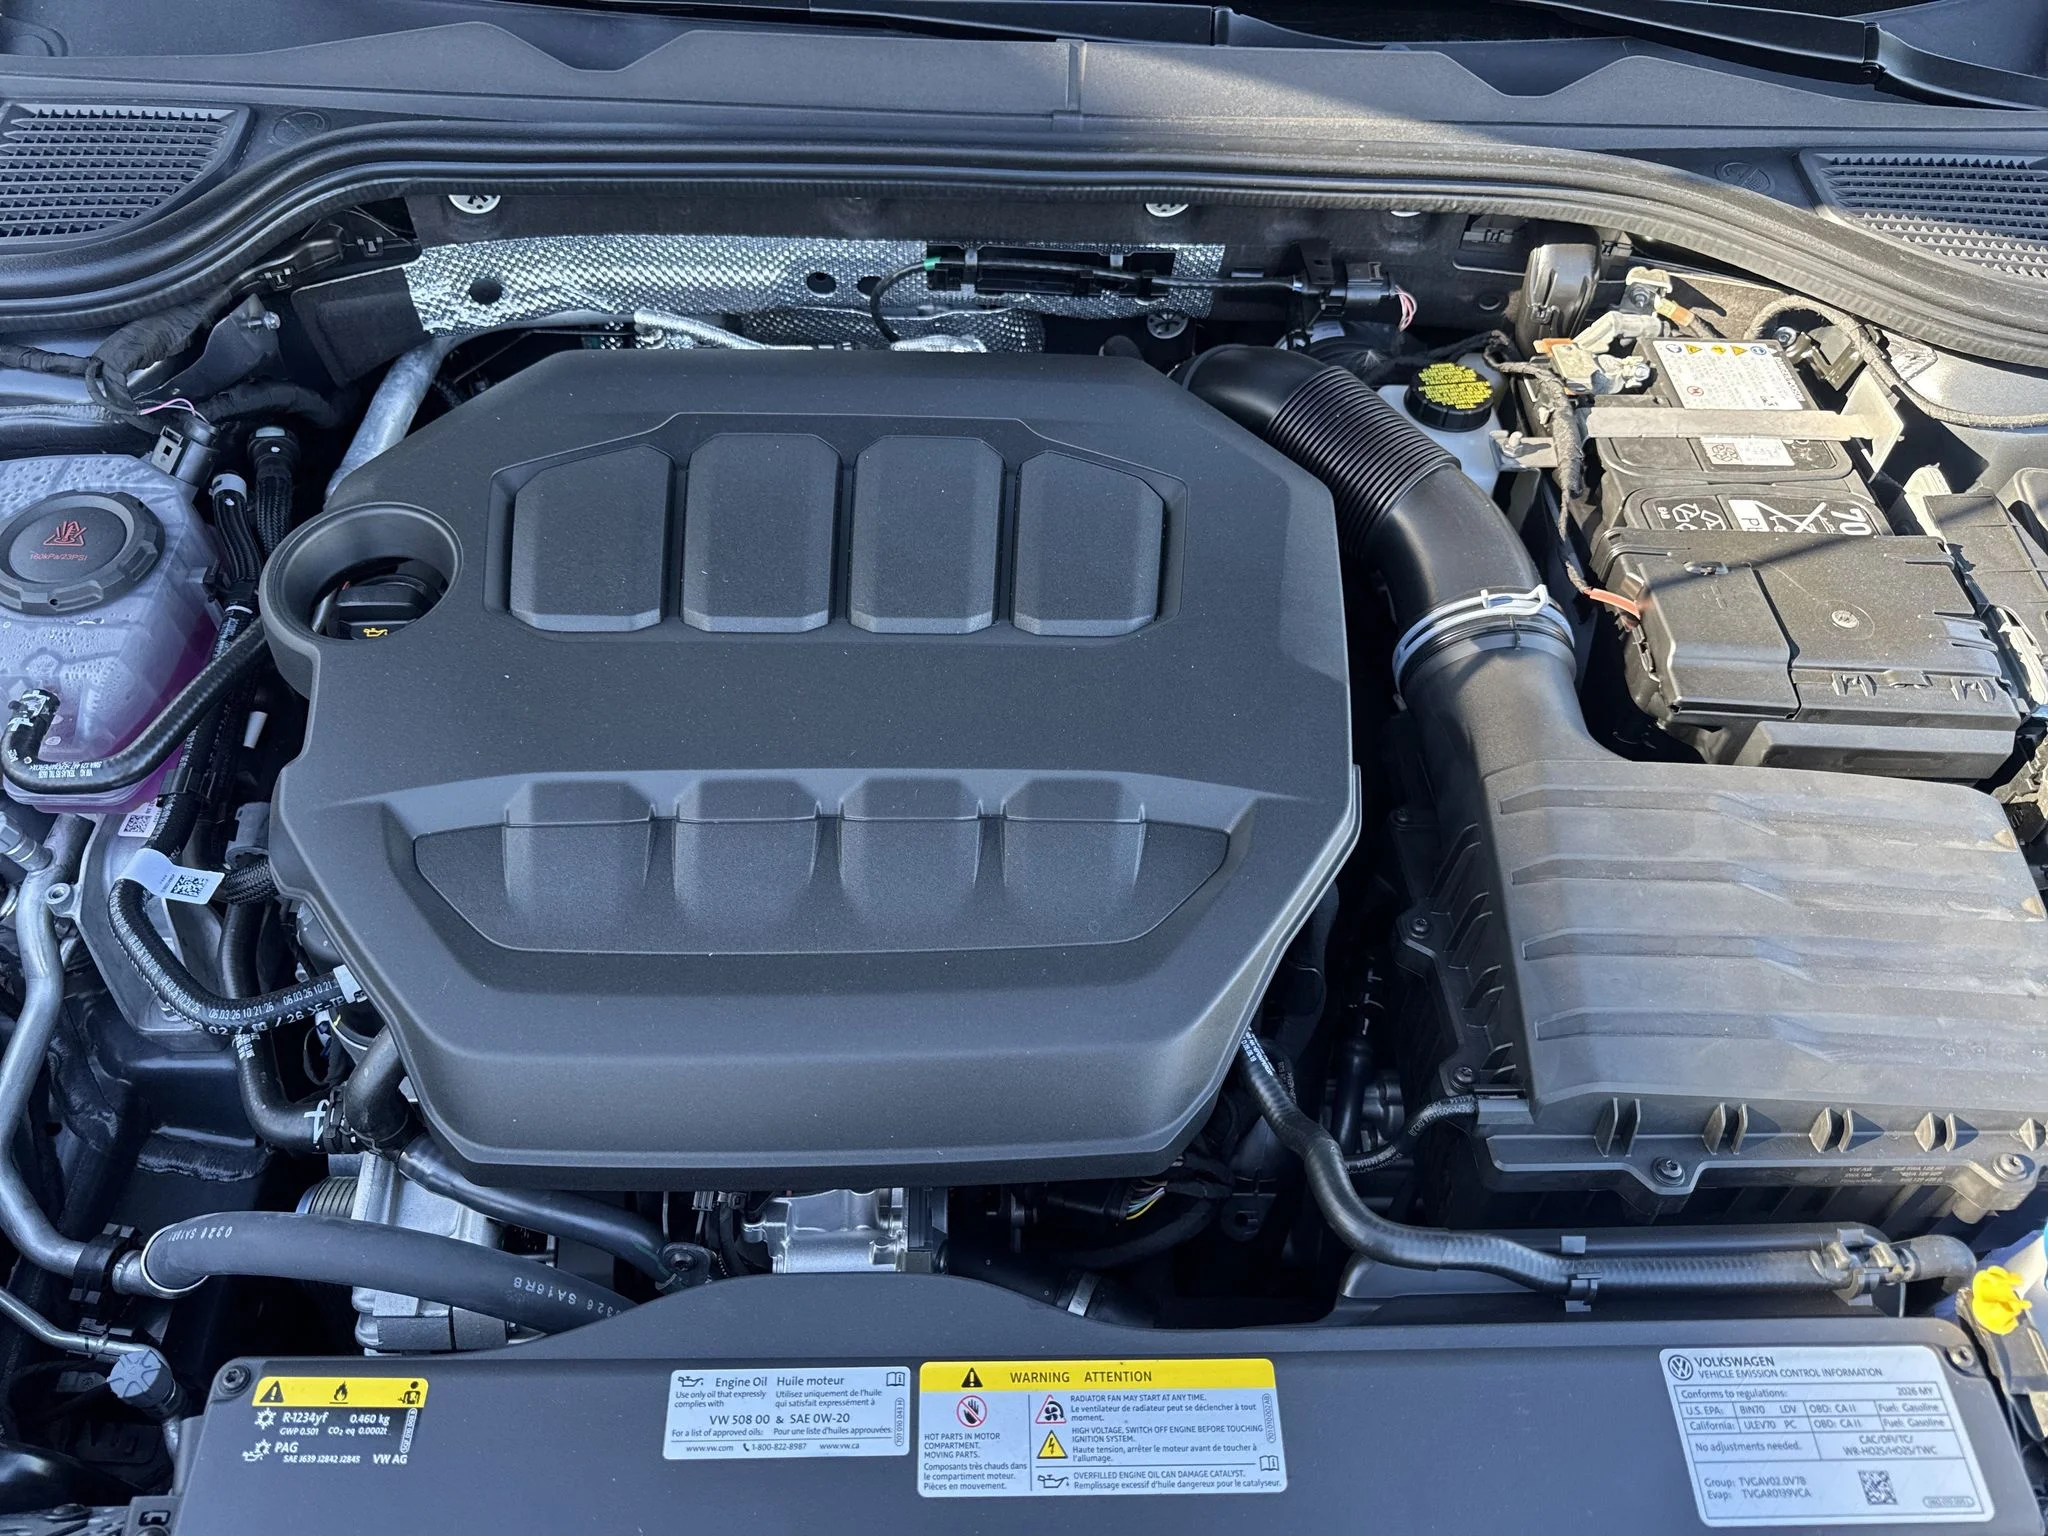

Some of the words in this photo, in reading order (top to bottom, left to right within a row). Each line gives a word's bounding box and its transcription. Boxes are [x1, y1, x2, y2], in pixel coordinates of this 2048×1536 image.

[1694, 1356, 1774, 1367] VOLKSWAGEN
[1009, 1371, 1069, 1383] WARNING
[1084, 1370, 1151, 1382] ATTENTION
[1698, 1369, 1734, 1379] VEHICLE
[1735, 1369, 1778, 1378] EMISSION
[1779, 1368, 1820, 1377] CONTROL
[1821, 1368, 1882, 1377] INFORMATION
[715, 1376, 750, 1390] Engine
[752, 1376, 767, 1386] Oil
[776, 1375, 803, 1386] Huile
[806, 1375, 844, 1385] moteur
[690, 1390, 705, 1400] only
[706, 1390, 716, 1398] oil
[717, 1390, 732, 1398] that
[733, 1389, 767, 1399] expressly
[775, 1390, 802, 1398] Utilisez
[803, 1389, 848, 1399] uniquement
[849, 1388, 859, 1396] de
[859, 1388, 883, 1398] l'huile
[1070, 1394, 1105, 1402] RADIATOR
[1680, 1388, 1723, 1399] Conforms
[1724, 1389, 1734, 1398] to
[674, 1399, 706, 1409] complies
[707, 1399, 724, 1407] with
[775, 1399, 787, 1408] qui
[788, 1398, 816, 1407] satisfait
[818, 1397, 869, 1408] expressément
[1080, 1404, 1119, 1412] ventilateur
[1121, 1404, 1130, 1412] de
[1166, 1404, 1183, 1413] peut
[1194, 1403, 1232, 1411] déclencher
[1685, 1405, 1701, 1415] U.S.
[282, 1411, 329, 1426] R-1234yf
[349, 1414, 376, 1427] 0.460
[378, 1413, 389, 1427] kg
[709, 1415, 729, 1425] VW
[732, 1414, 752, 1424] 508
[755, 1414, 770, 1424] 00
[775, 1415, 784, 1424] &
[789, 1413, 810, 1423] SAE
[812, 1412, 850, 1423] 0W-20
[1070, 1414, 1104, 1422] moment.
[279, 1427, 298, 1435] GWP
[345, 1428, 355, 1436] eq
[671, 1428, 683, 1437] For
[690, 1428, 702, 1436] list
[703, 1428, 711, 1436] of
[712, 1427, 747, 1437] approved
[748, 1427, 763, 1435] oils:
[773, 1427, 789, 1435] Pour
[821, 1426, 849, 1434] d'huiles
[1071, 1426, 1089, 1434] HIGH
[1153, 1425, 1167, 1433] OFF
[1169, 1425, 1195, 1433] ENGINE
[1226, 1424, 1263, 1432] TOUCHING
[924, 1432, 939, 1440] HOT
[940, 1432, 963, 1440] PARTS
[973, 1432, 1000, 1440] MOTOR
[1071, 1435, 1104, 1443] IGNITION
[1105, 1434, 1135, 1442] SYSTEM.
[274, 1441, 298, 1453] PAG
[752, 1442, 806, 1451] 1-800-822-8987
[923, 1441, 981, 1449] COMPARTMENT.
[1072, 1445, 1094, 1453] Haute
[1096, 1445, 1125, 1454] tension,
[1153, 1444, 1160, 1452] le
[1190, 1444, 1210, 1452] avant
[1212, 1443, 1221, 1451] de
[1223, 1443, 1250, 1451] toucher
[1695, 1442, 1708, 1452] No
[1710, 1440, 1765, 1453] adjustments
[283, 1454, 297, 1462] SAE
[299, 1454, 316, 1462] J639
[373, 1454, 390, 1464] VW
[392, 1454, 407, 1464] AG
[924, 1450, 953, 1458] MOVING
[955, 1450, 980, 1458] PARTS.
[923, 1462, 967, 1472] Composants
[968, 1461, 982, 1470] très
[983, 1461, 1009, 1470] chauds
[1010, 1461, 1027, 1469] dans
[923, 1472, 930, 1480] le
[932, 1472, 985, 1481] compartiment
[1073, 1471, 1117, 1479] OVERFILLED
[1118, 1471, 1145, 1479] ENGINE
[1147, 1470, 1159, 1478] OIL
[1160, 1470, 1176, 1478] CAN
[1177, 1470, 1208, 1478] DAMAGE
[1209, 1469, 1245, 1477] CATALYST.
[923, 1482, 947, 1490] Pièces
[1073, 1480, 1119, 1491] Remplissage
[1120, 1480, 1149, 1488] excessif
[1150, 1480, 1175, 1488] d'huile
[1176, 1479, 1214, 1489] dangereux
[1216, 1480, 1232, 1488] pour
[1234, 1478, 1241, 1487] le
[1242, 1478, 1281, 1488] catalyseur.
